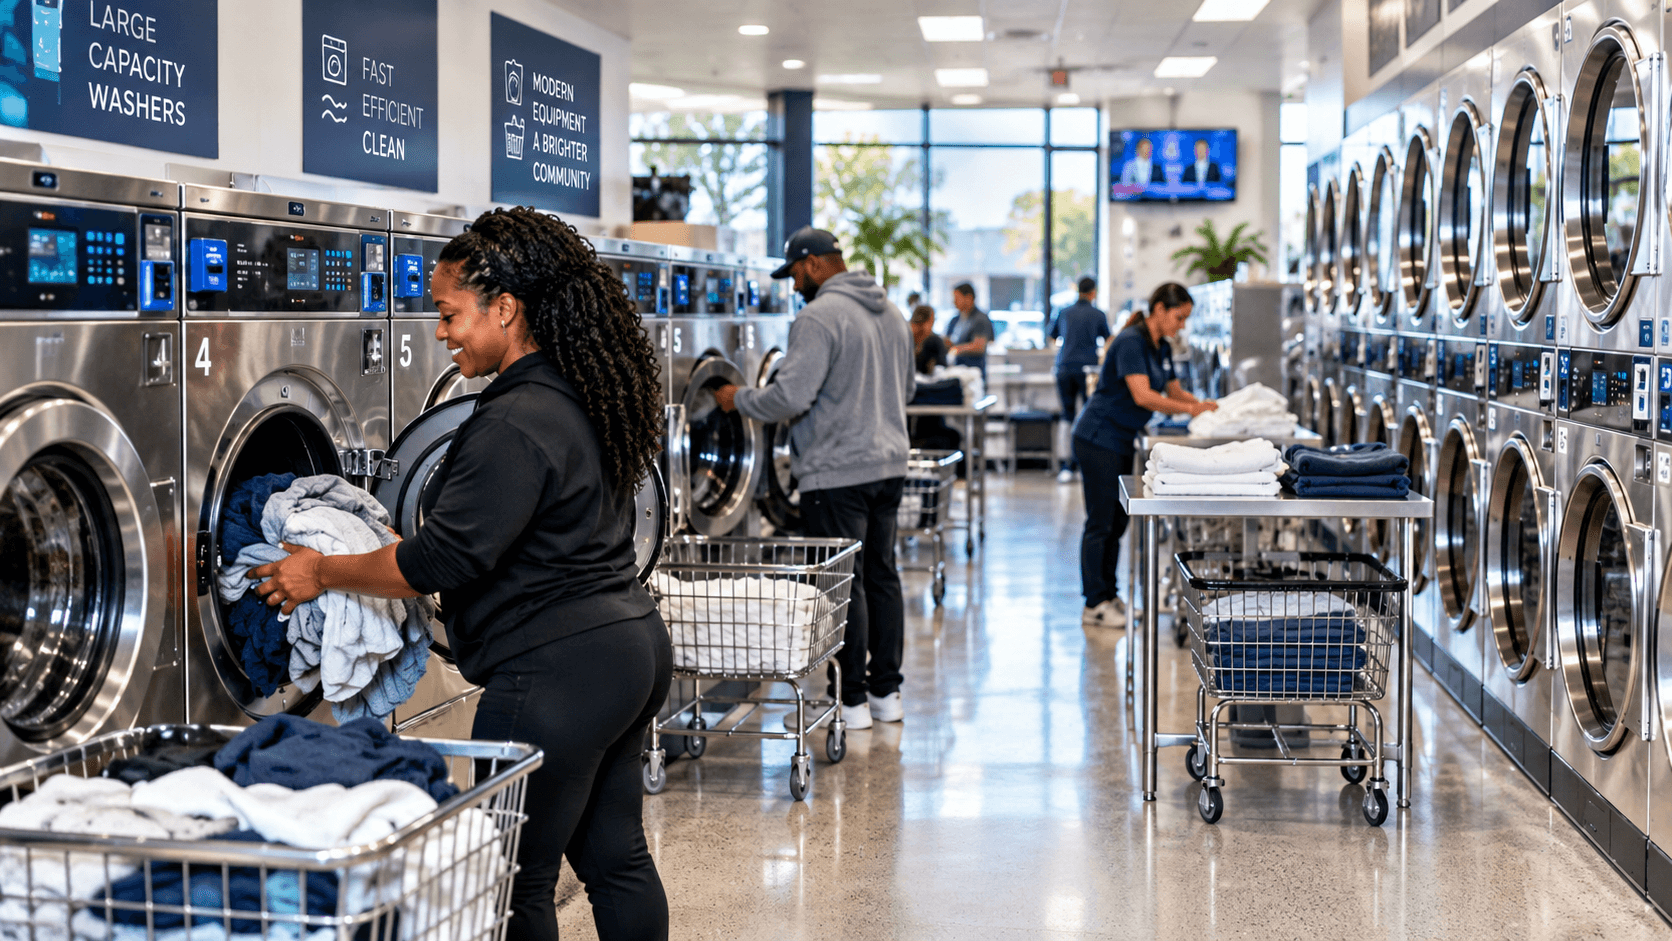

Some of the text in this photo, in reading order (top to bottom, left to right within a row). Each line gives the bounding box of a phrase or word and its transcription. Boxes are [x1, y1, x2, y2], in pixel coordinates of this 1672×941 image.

[89, 0, 157, 44] LARGE
[89, 42, 186, 88] CAPACITY
[362, 56, 395, 87] FAST
[532, 71, 574, 102] MODERN
[88, 81, 186, 126] WASHERS
[362, 93, 424, 129] EFFICIENT
[532, 101, 587, 134] EQUIPMENT
[363, 130, 405, 161] CLEAN
[532, 131, 588, 163] A BRIGHTER
[532, 161, 591, 191] COMMUNITY
[194, 337, 212, 376] 4
[399, 334, 412, 368] 5
